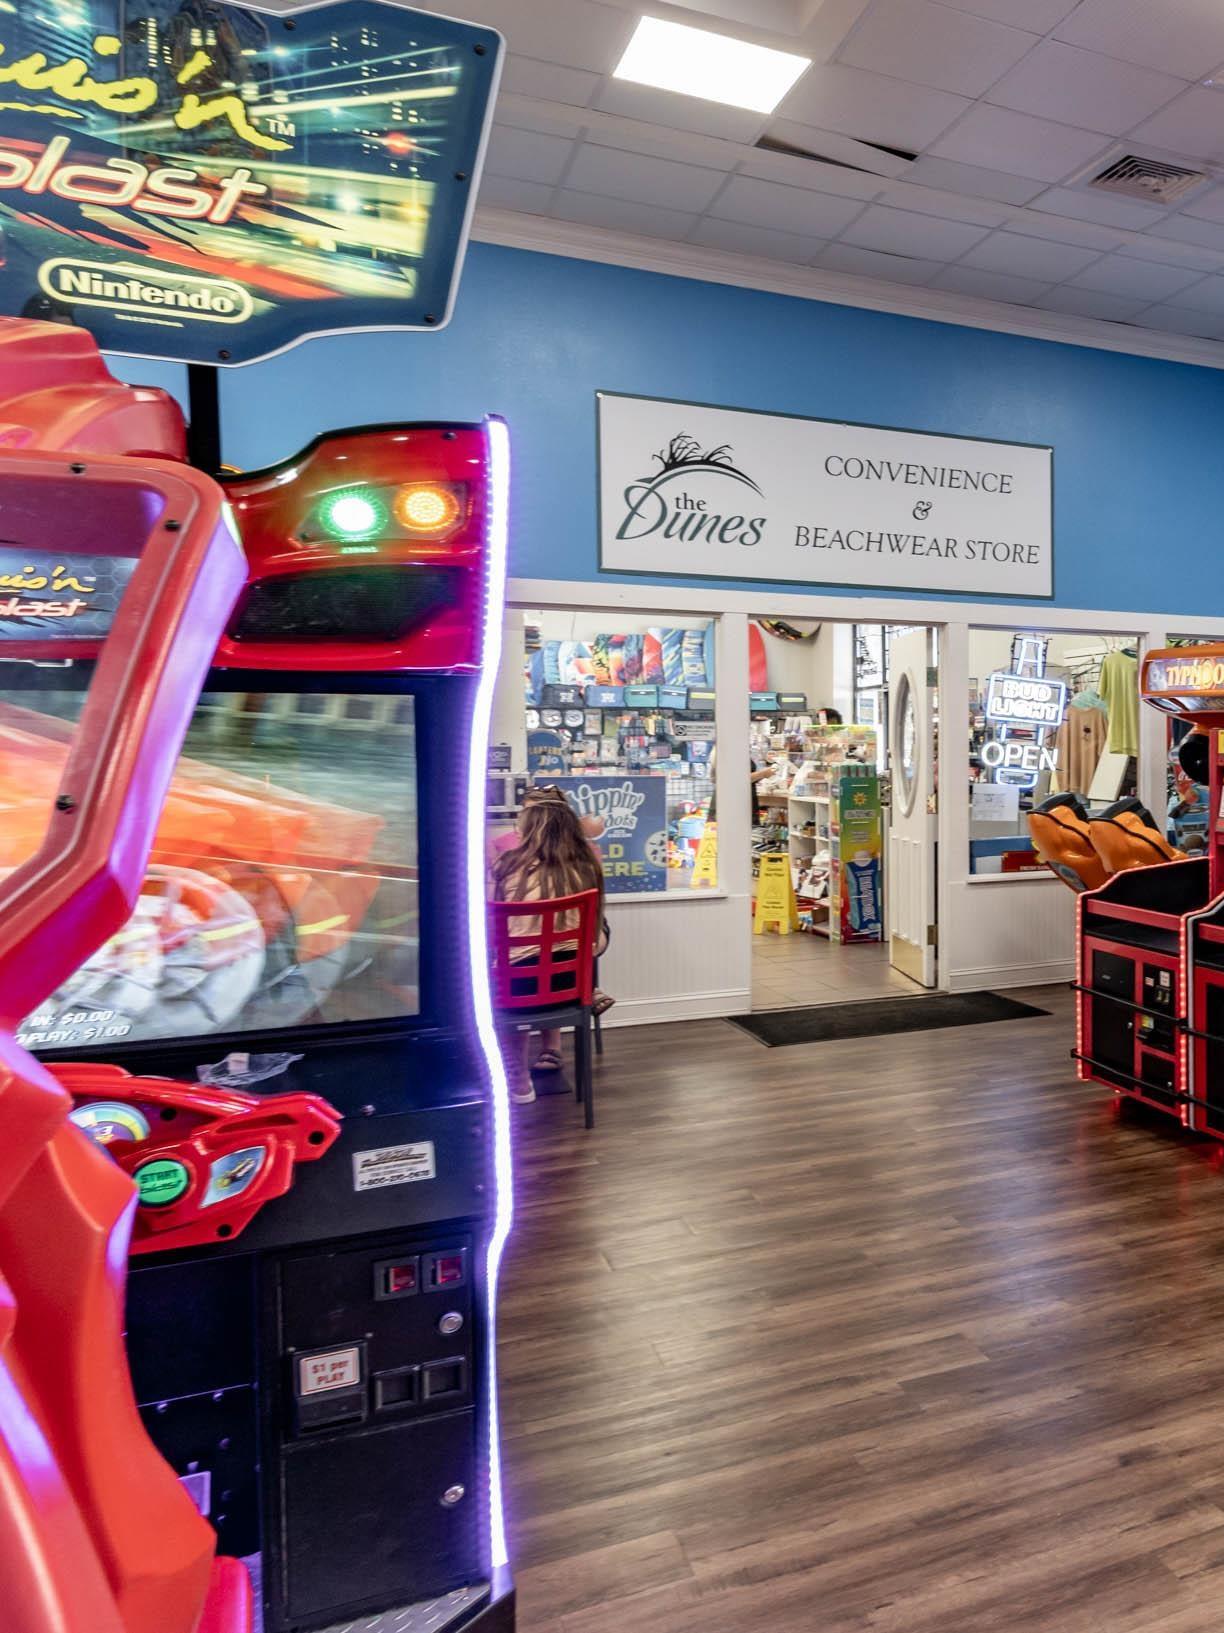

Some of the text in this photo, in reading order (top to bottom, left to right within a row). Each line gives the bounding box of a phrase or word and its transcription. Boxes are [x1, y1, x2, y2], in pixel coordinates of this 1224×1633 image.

[60, 268, 236, 314] Nintendo
[824, 455, 1013, 495] CONVENIENCE
[675, 493, 706, 511] the
[912, 500, 932, 520] &
[615, 485, 767, 548] Dunes
[794, 525, 1040, 565] BEACHWEAR STORE
[0, 597, 88, 617] last
[1002, 680, 1052, 702] BUD
[981, 741, 1059, 771] OPEN
[566, 781, 645, 817] ippin'
[603, 861, 645, 877] ERE
[61, 1010, 114, 1025] $0.00
[26, 1030, 80, 1043] PLAY:
[84, 1025, 131, 1040] $1.00
[317, 1372, 345, 1385] PLAY
